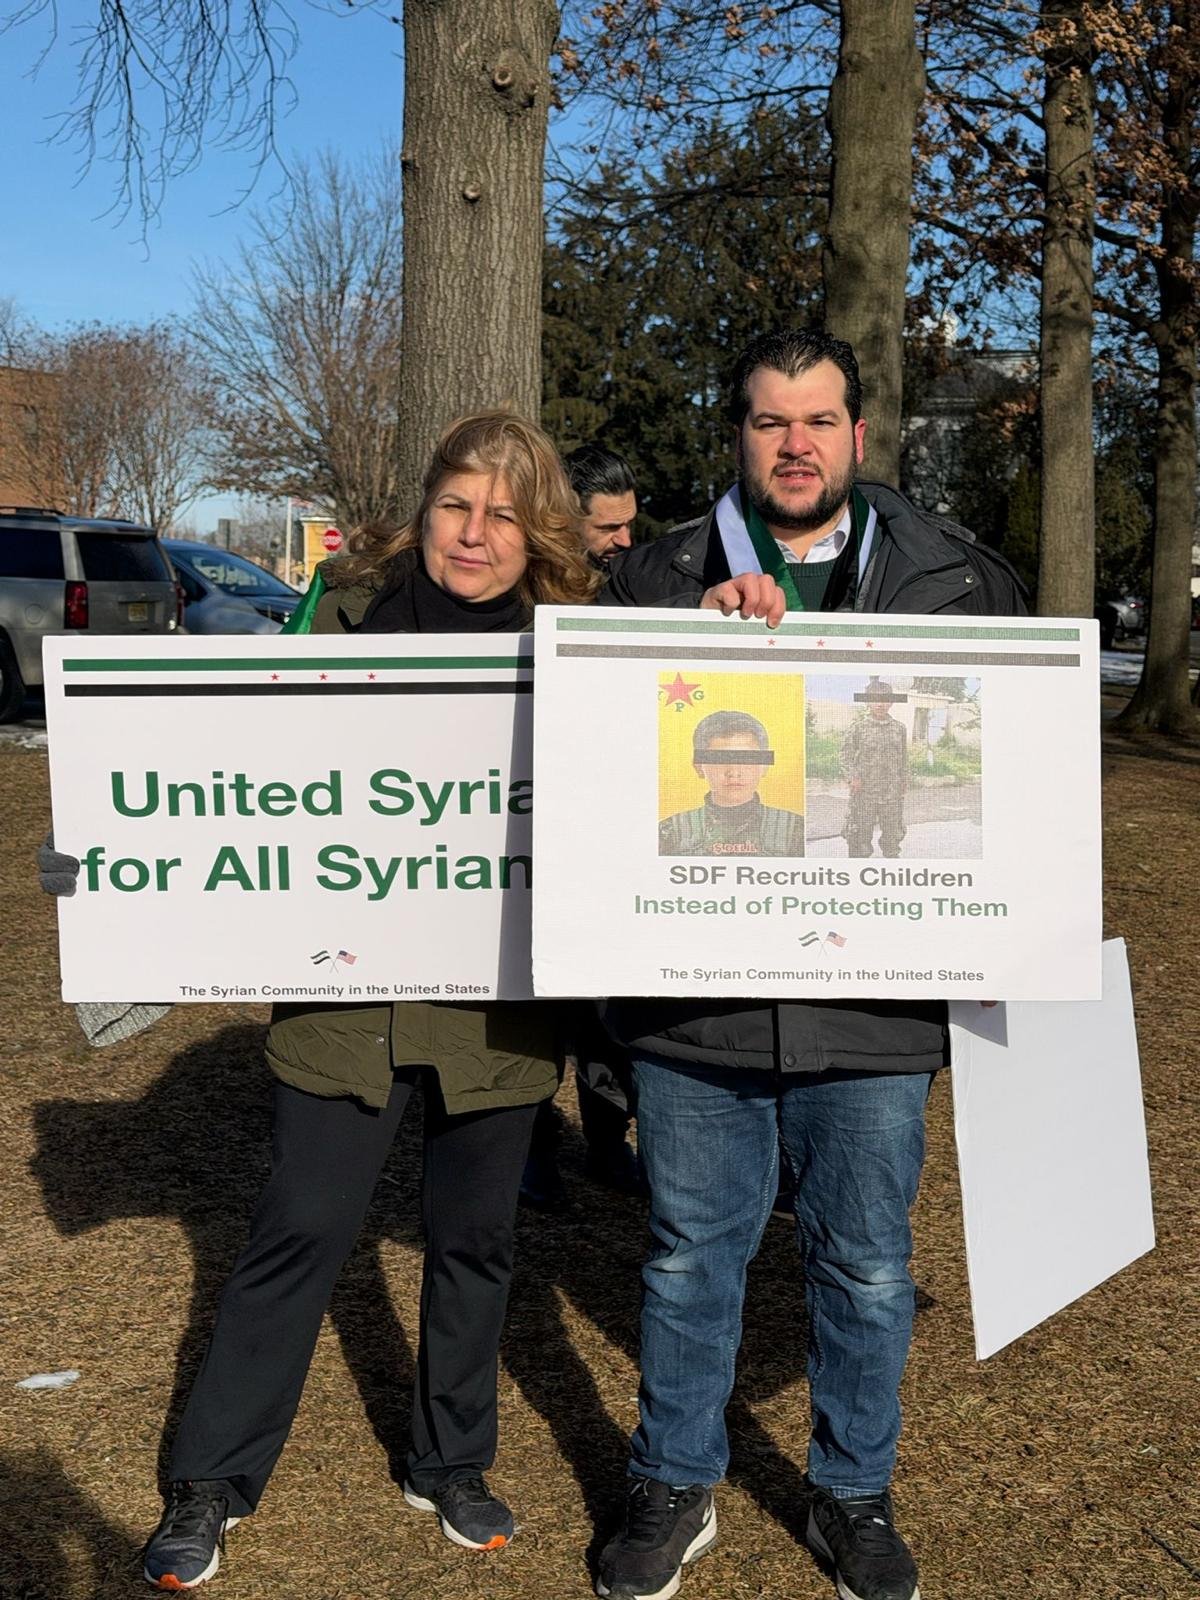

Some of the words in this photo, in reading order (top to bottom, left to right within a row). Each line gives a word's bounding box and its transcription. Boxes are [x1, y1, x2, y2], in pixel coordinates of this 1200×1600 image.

[111, 769, 342, 817] United
[368, 768, 533, 827] Syria
[79, 847, 182, 892] for
[203, 845, 291, 892] All
[669, 865, 727, 885] SDF
[736, 866, 851, 887] Recruits
[859, 866, 973, 888] Children
[635, 894, 736, 915] Instead
[745, 895, 773, 915] of
[781, 896, 923, 921] Protecting
[932, 897, 1008, 917] Them
[660, 967, 689, 980] The
[693, 968, 742, 983] Syrian
[746, 968, 834, 983] Community
[838, 968, 852, 980] in
[856, 969, 880, 981] the
[884, 969, 933, 981] United
[937, 969, 985, 981] States
[179, 985, 207, 996] The
[210, 985, 257, 999] Syrian
[261, 985, 345, 999] Community
[348, 984, 362, 995] in
[366, 984, 390, 995] the
[393, 983, 440, 995] United
[444, 983, 490, 995] States
